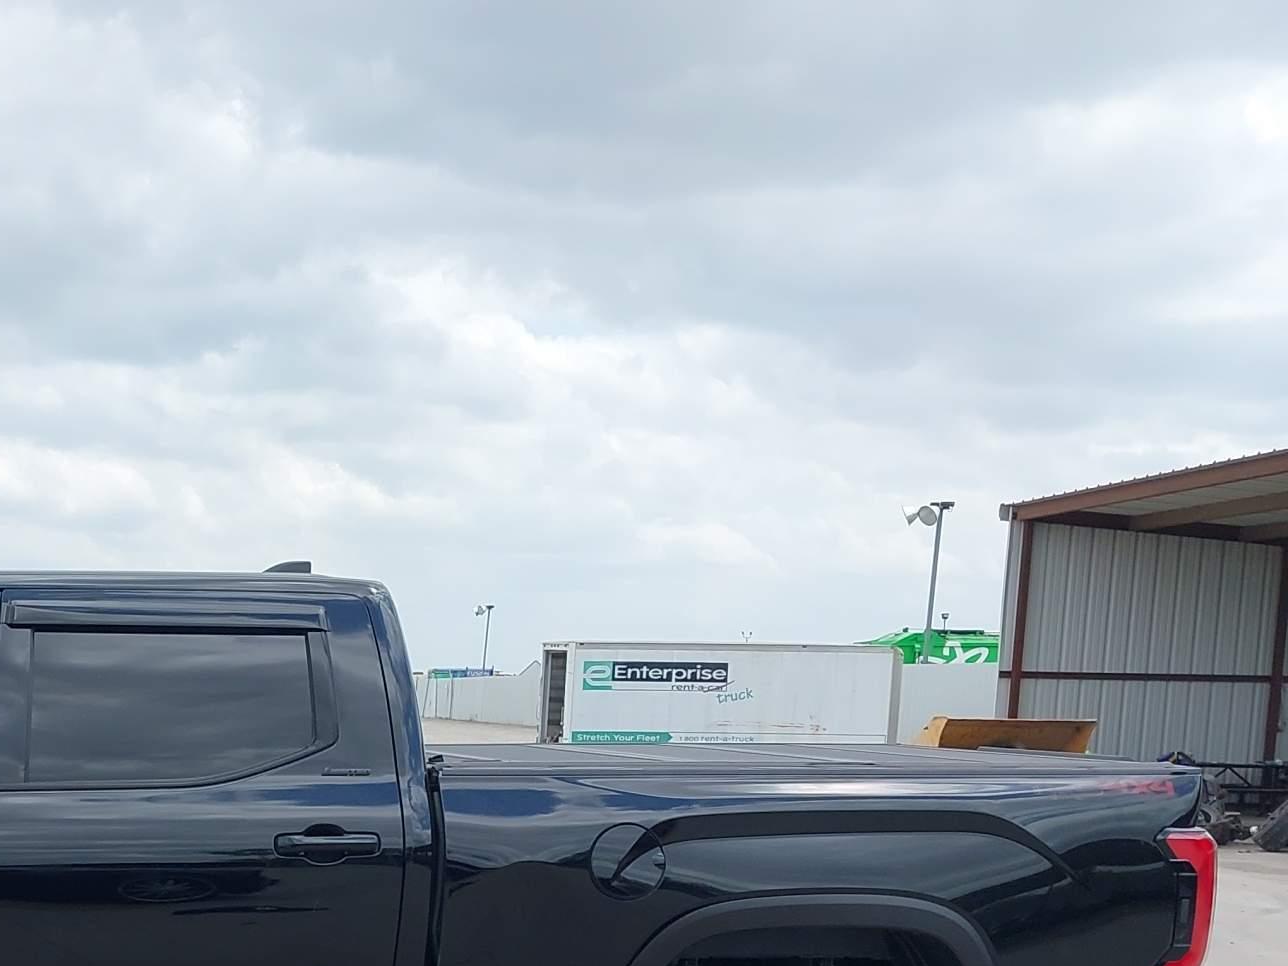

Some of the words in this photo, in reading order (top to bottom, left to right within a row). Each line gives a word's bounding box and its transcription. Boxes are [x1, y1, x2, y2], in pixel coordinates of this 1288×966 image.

[613, 664, 727, 682] Enterprise
[716, 688, 754, 704] truck
[576, 733, 611, 741] Stretch
[613, 734, 634, 742] Your
[636, 734, 661, 742] Fleet
